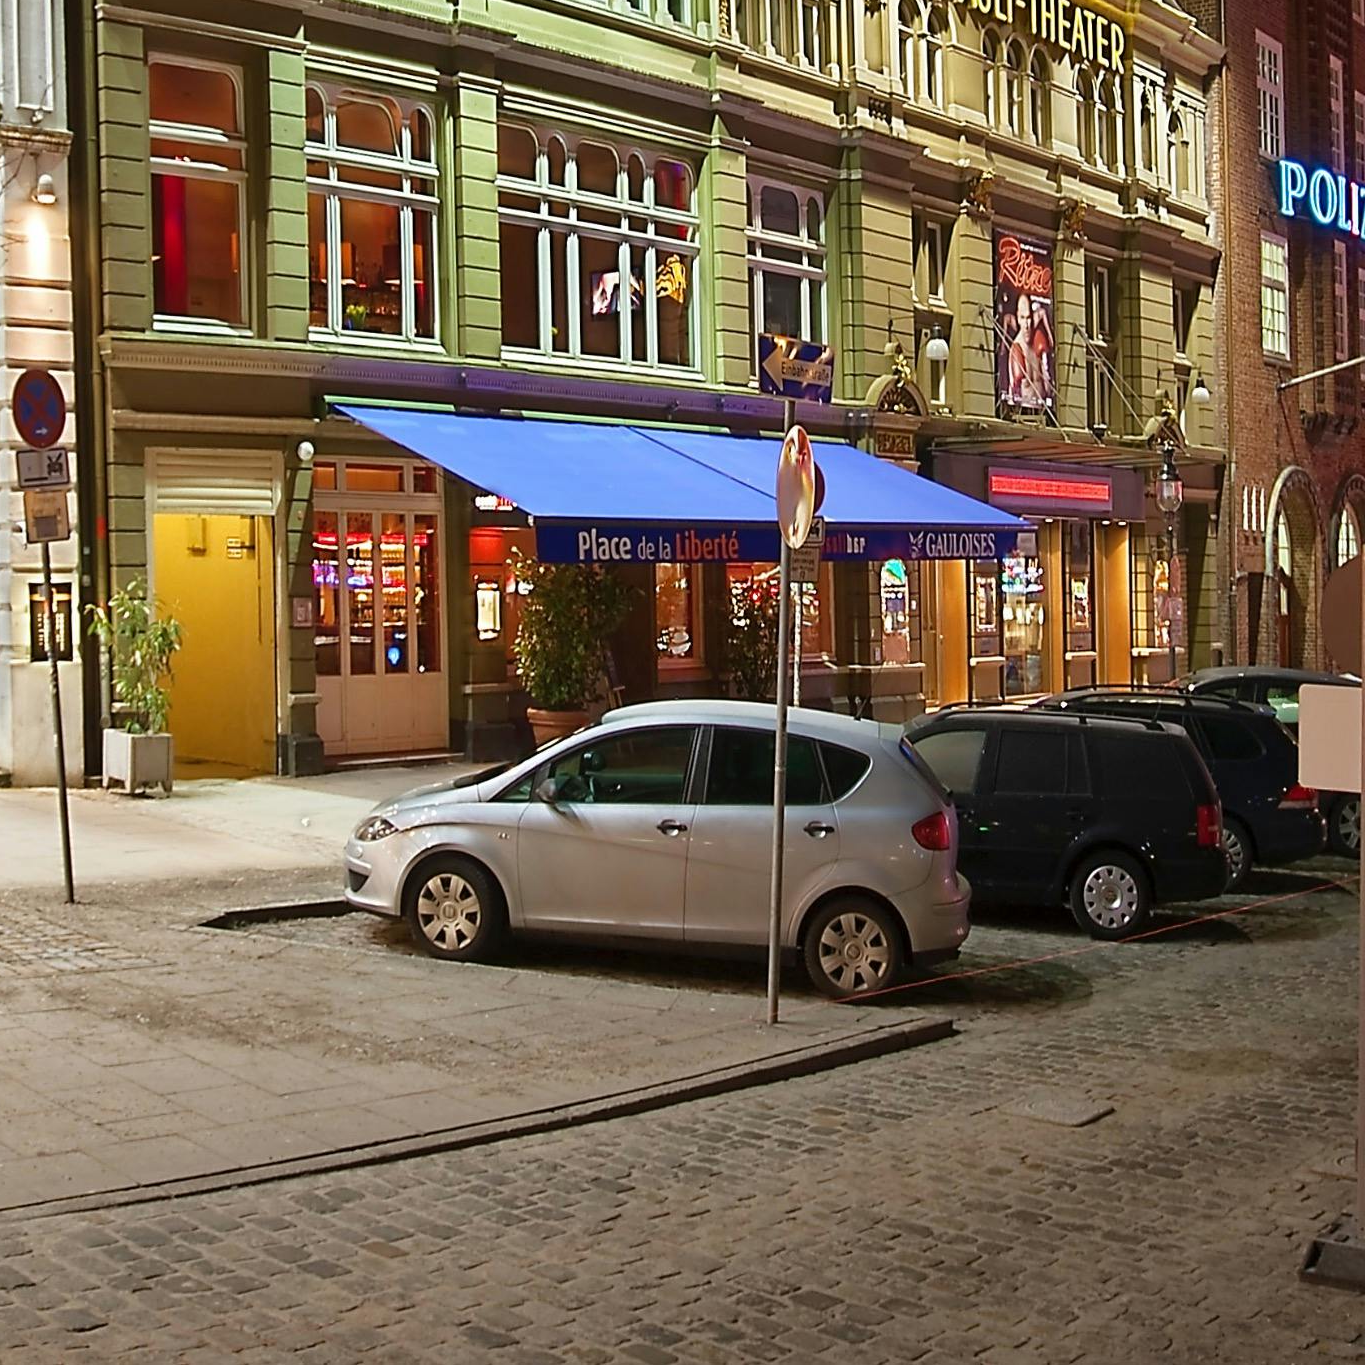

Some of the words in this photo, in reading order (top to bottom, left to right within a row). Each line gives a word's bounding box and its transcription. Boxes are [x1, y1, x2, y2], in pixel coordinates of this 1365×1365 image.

[578, 528, 631, 560] Place
[638, 536, 654, 560] de
[659, 536, 671, 560] la
[676, 530, 739, 559] Liberté
[926, 534, 996, 557] GAULOISES
